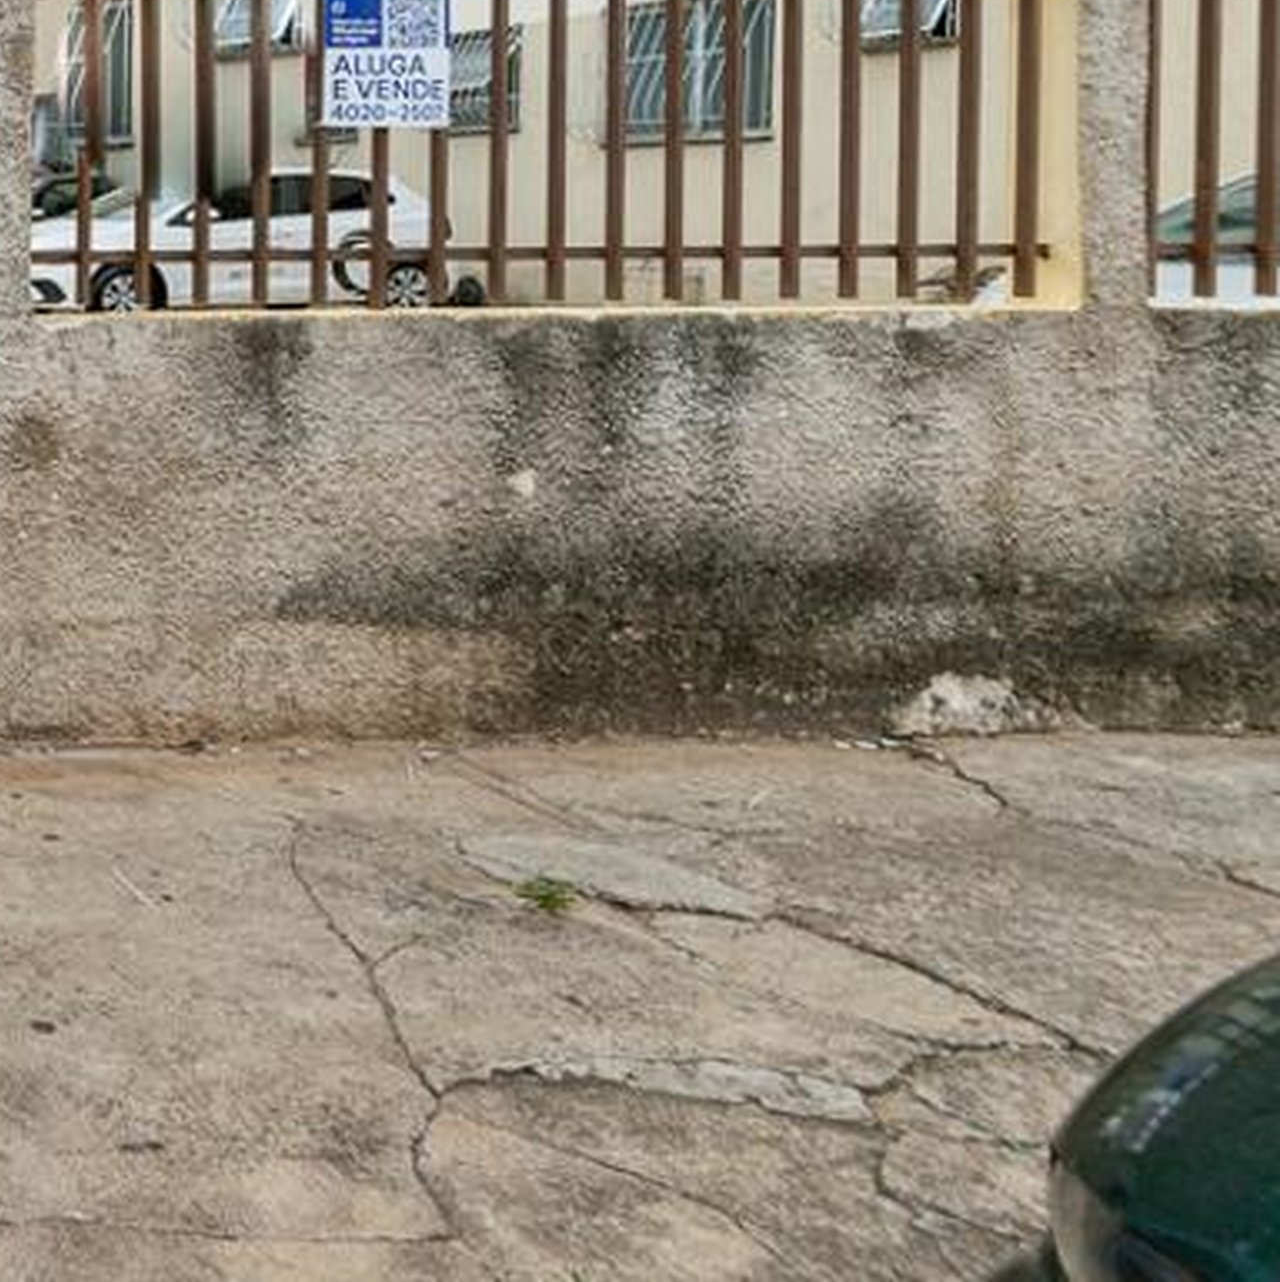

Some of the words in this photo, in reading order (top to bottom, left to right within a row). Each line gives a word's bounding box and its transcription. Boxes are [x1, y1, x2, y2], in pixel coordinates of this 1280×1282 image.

[332, 54, 426, 77] ALUGA
[333, 79, 348, 100] E
[355, 79, 445, 101] VENDE
